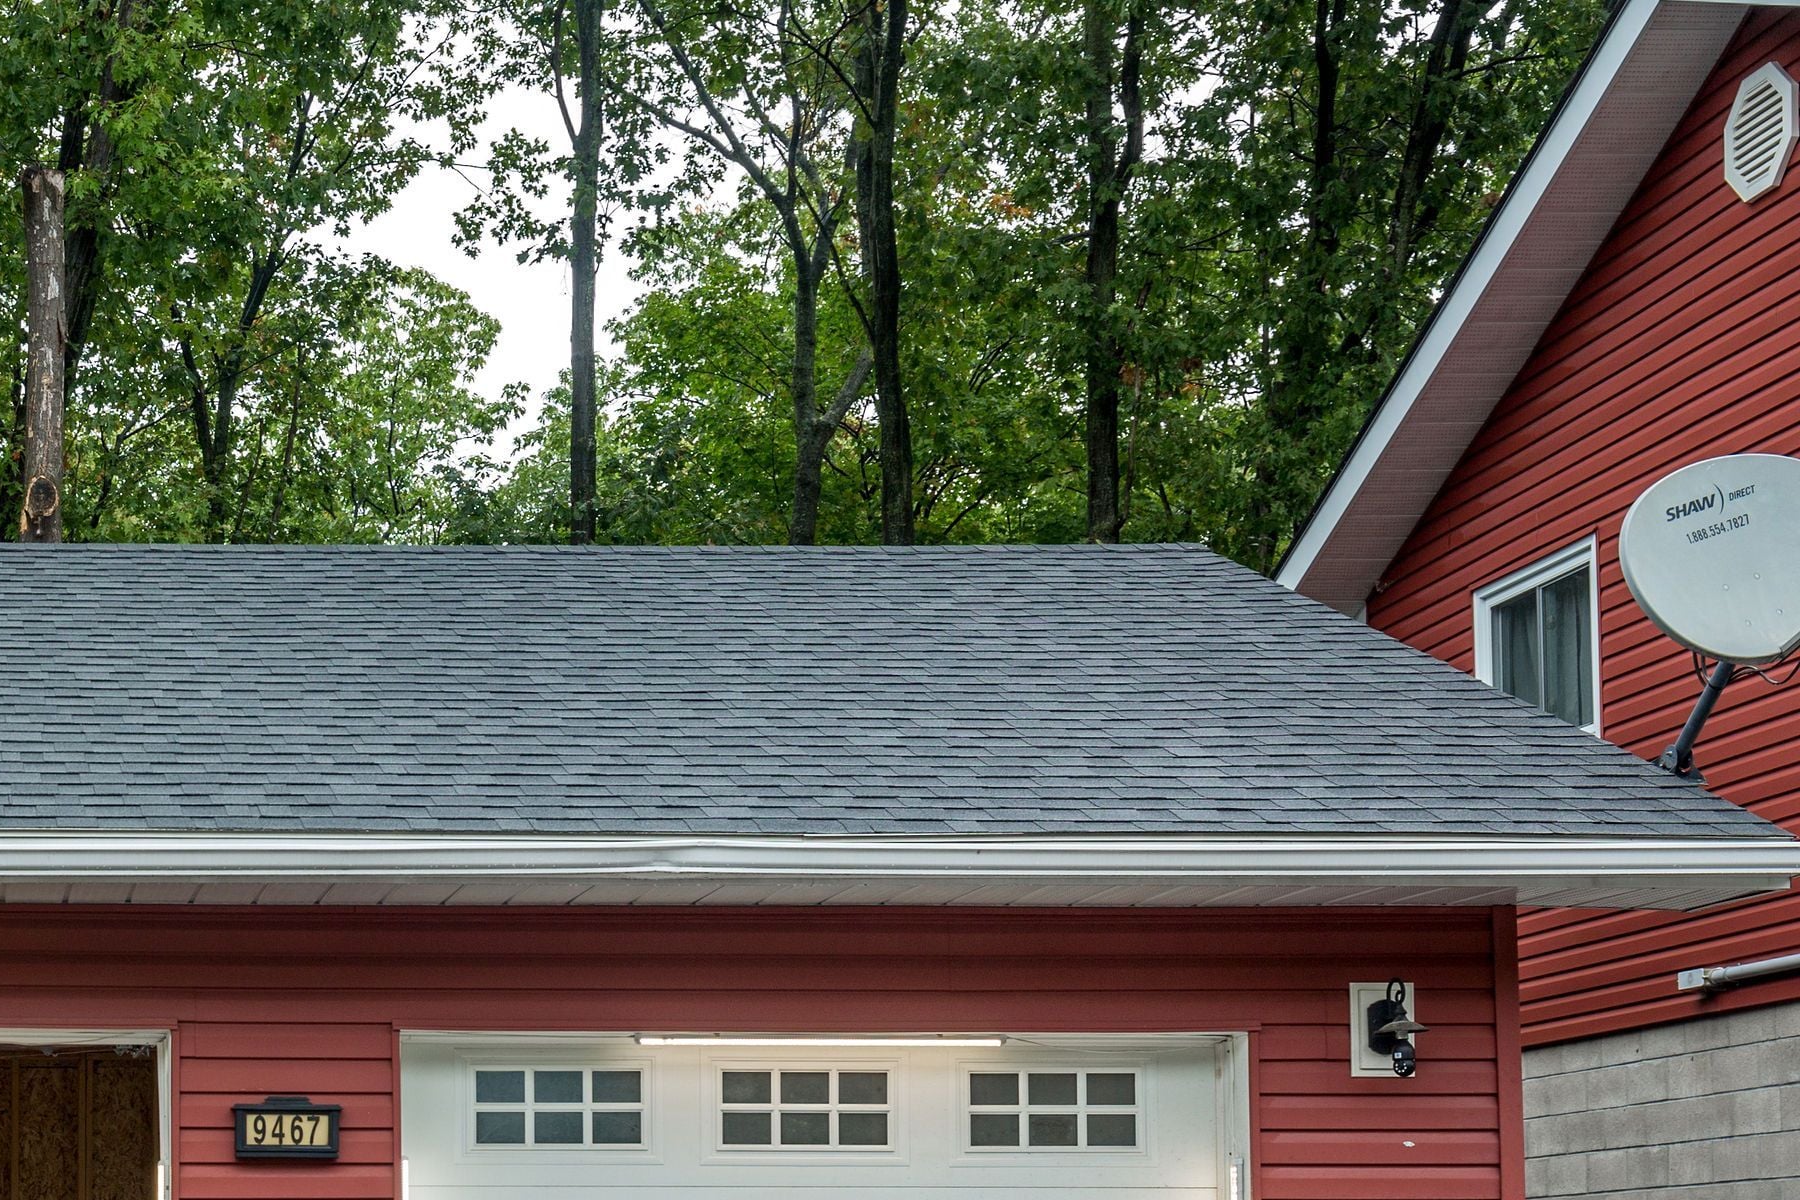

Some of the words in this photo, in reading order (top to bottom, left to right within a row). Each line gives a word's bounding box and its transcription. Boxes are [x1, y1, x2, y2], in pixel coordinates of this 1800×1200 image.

[1666, 493, 1715, 522] SHAW
[1729, 484, 1755, 501] DIRECT
[1686, 513, 1750, 544] 1.888.554.7827
[253, 1115, 320, 1146] 9467
